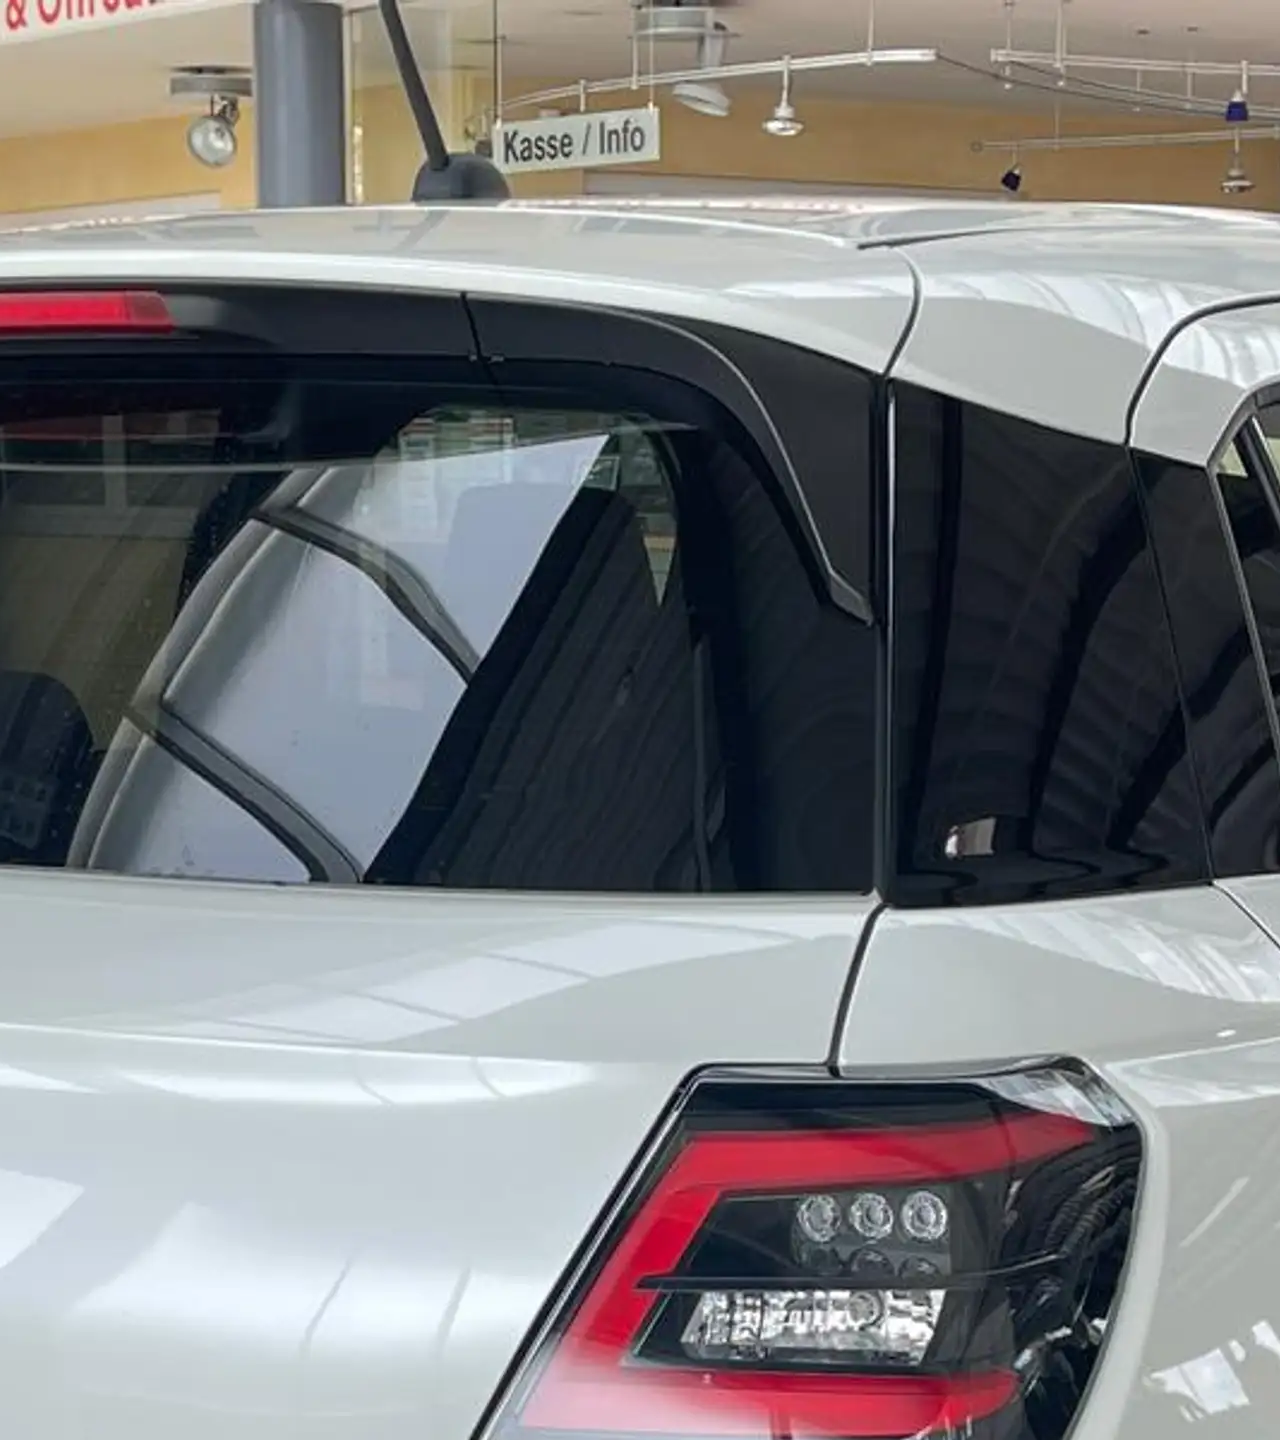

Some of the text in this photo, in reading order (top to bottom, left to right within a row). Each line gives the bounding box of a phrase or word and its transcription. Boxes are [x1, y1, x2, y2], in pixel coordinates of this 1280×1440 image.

[6, 0, 28, 30] &
[502, 118, 646, 164] Kasse / Info
